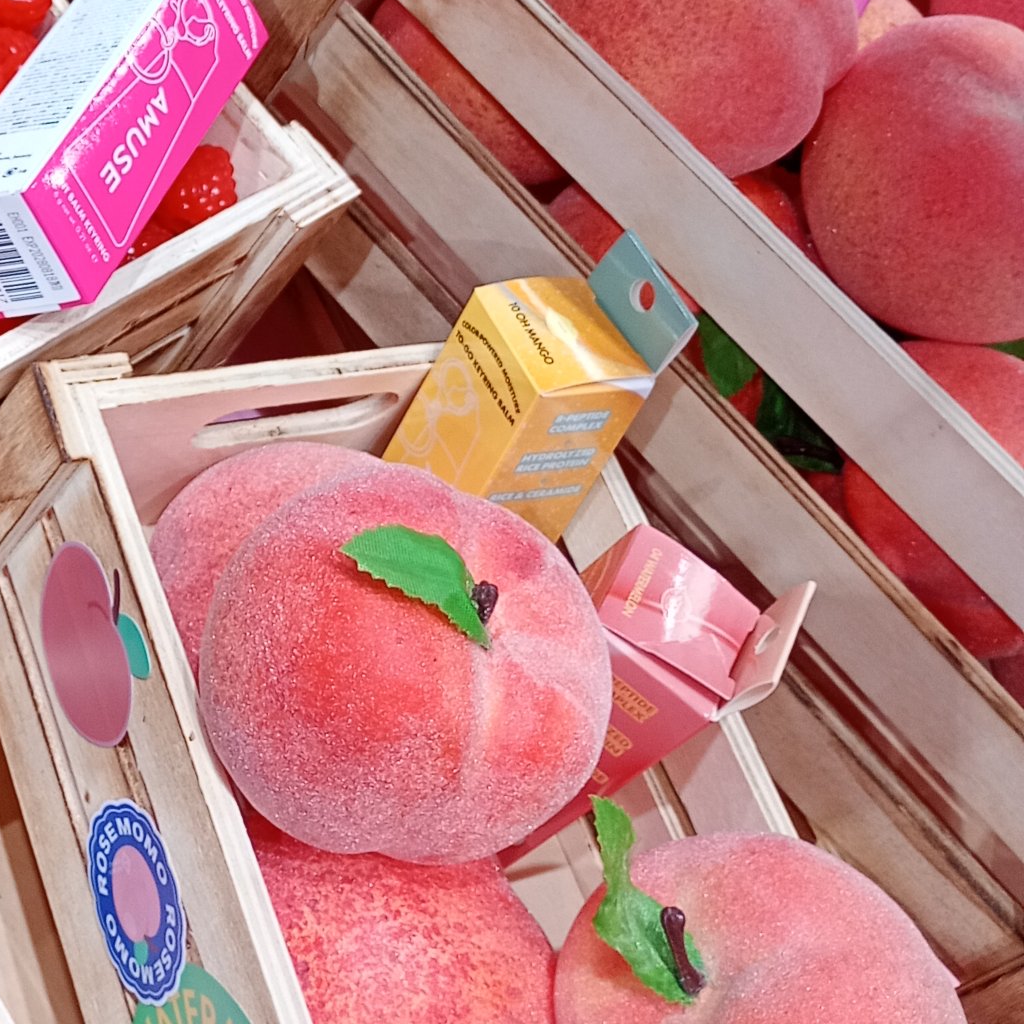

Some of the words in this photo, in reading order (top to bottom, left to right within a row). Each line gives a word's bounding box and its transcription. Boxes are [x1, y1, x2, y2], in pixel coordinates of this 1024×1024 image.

[100, 87, 170, 194] AMUSE
[67, 191, 86, 221] BALM
[83, 219, 110, 262] KEYRING
[515, 312, 530, 328] OH
[528, 327, 554, 365] MANGO
[455, 330, 474, 360] TO-GO
[473, 359, 498, 399] KEYRING
[497, 399, 515, 426] BALM
[502, 368, 521, 413] MOISTURE
[522, 448, 595, 462] HYDROLYZED
[549, 421, 602, 434] COMPLEX
[516, 462, 540, 473] RICE
[539, 458, 589, 471] PROTEIN
[622, 560, 658, 619] WATERMELON
[96, 817, 167, 896] ROSEMOMO
[104, 904, 176, 986] ROSEMOMO
